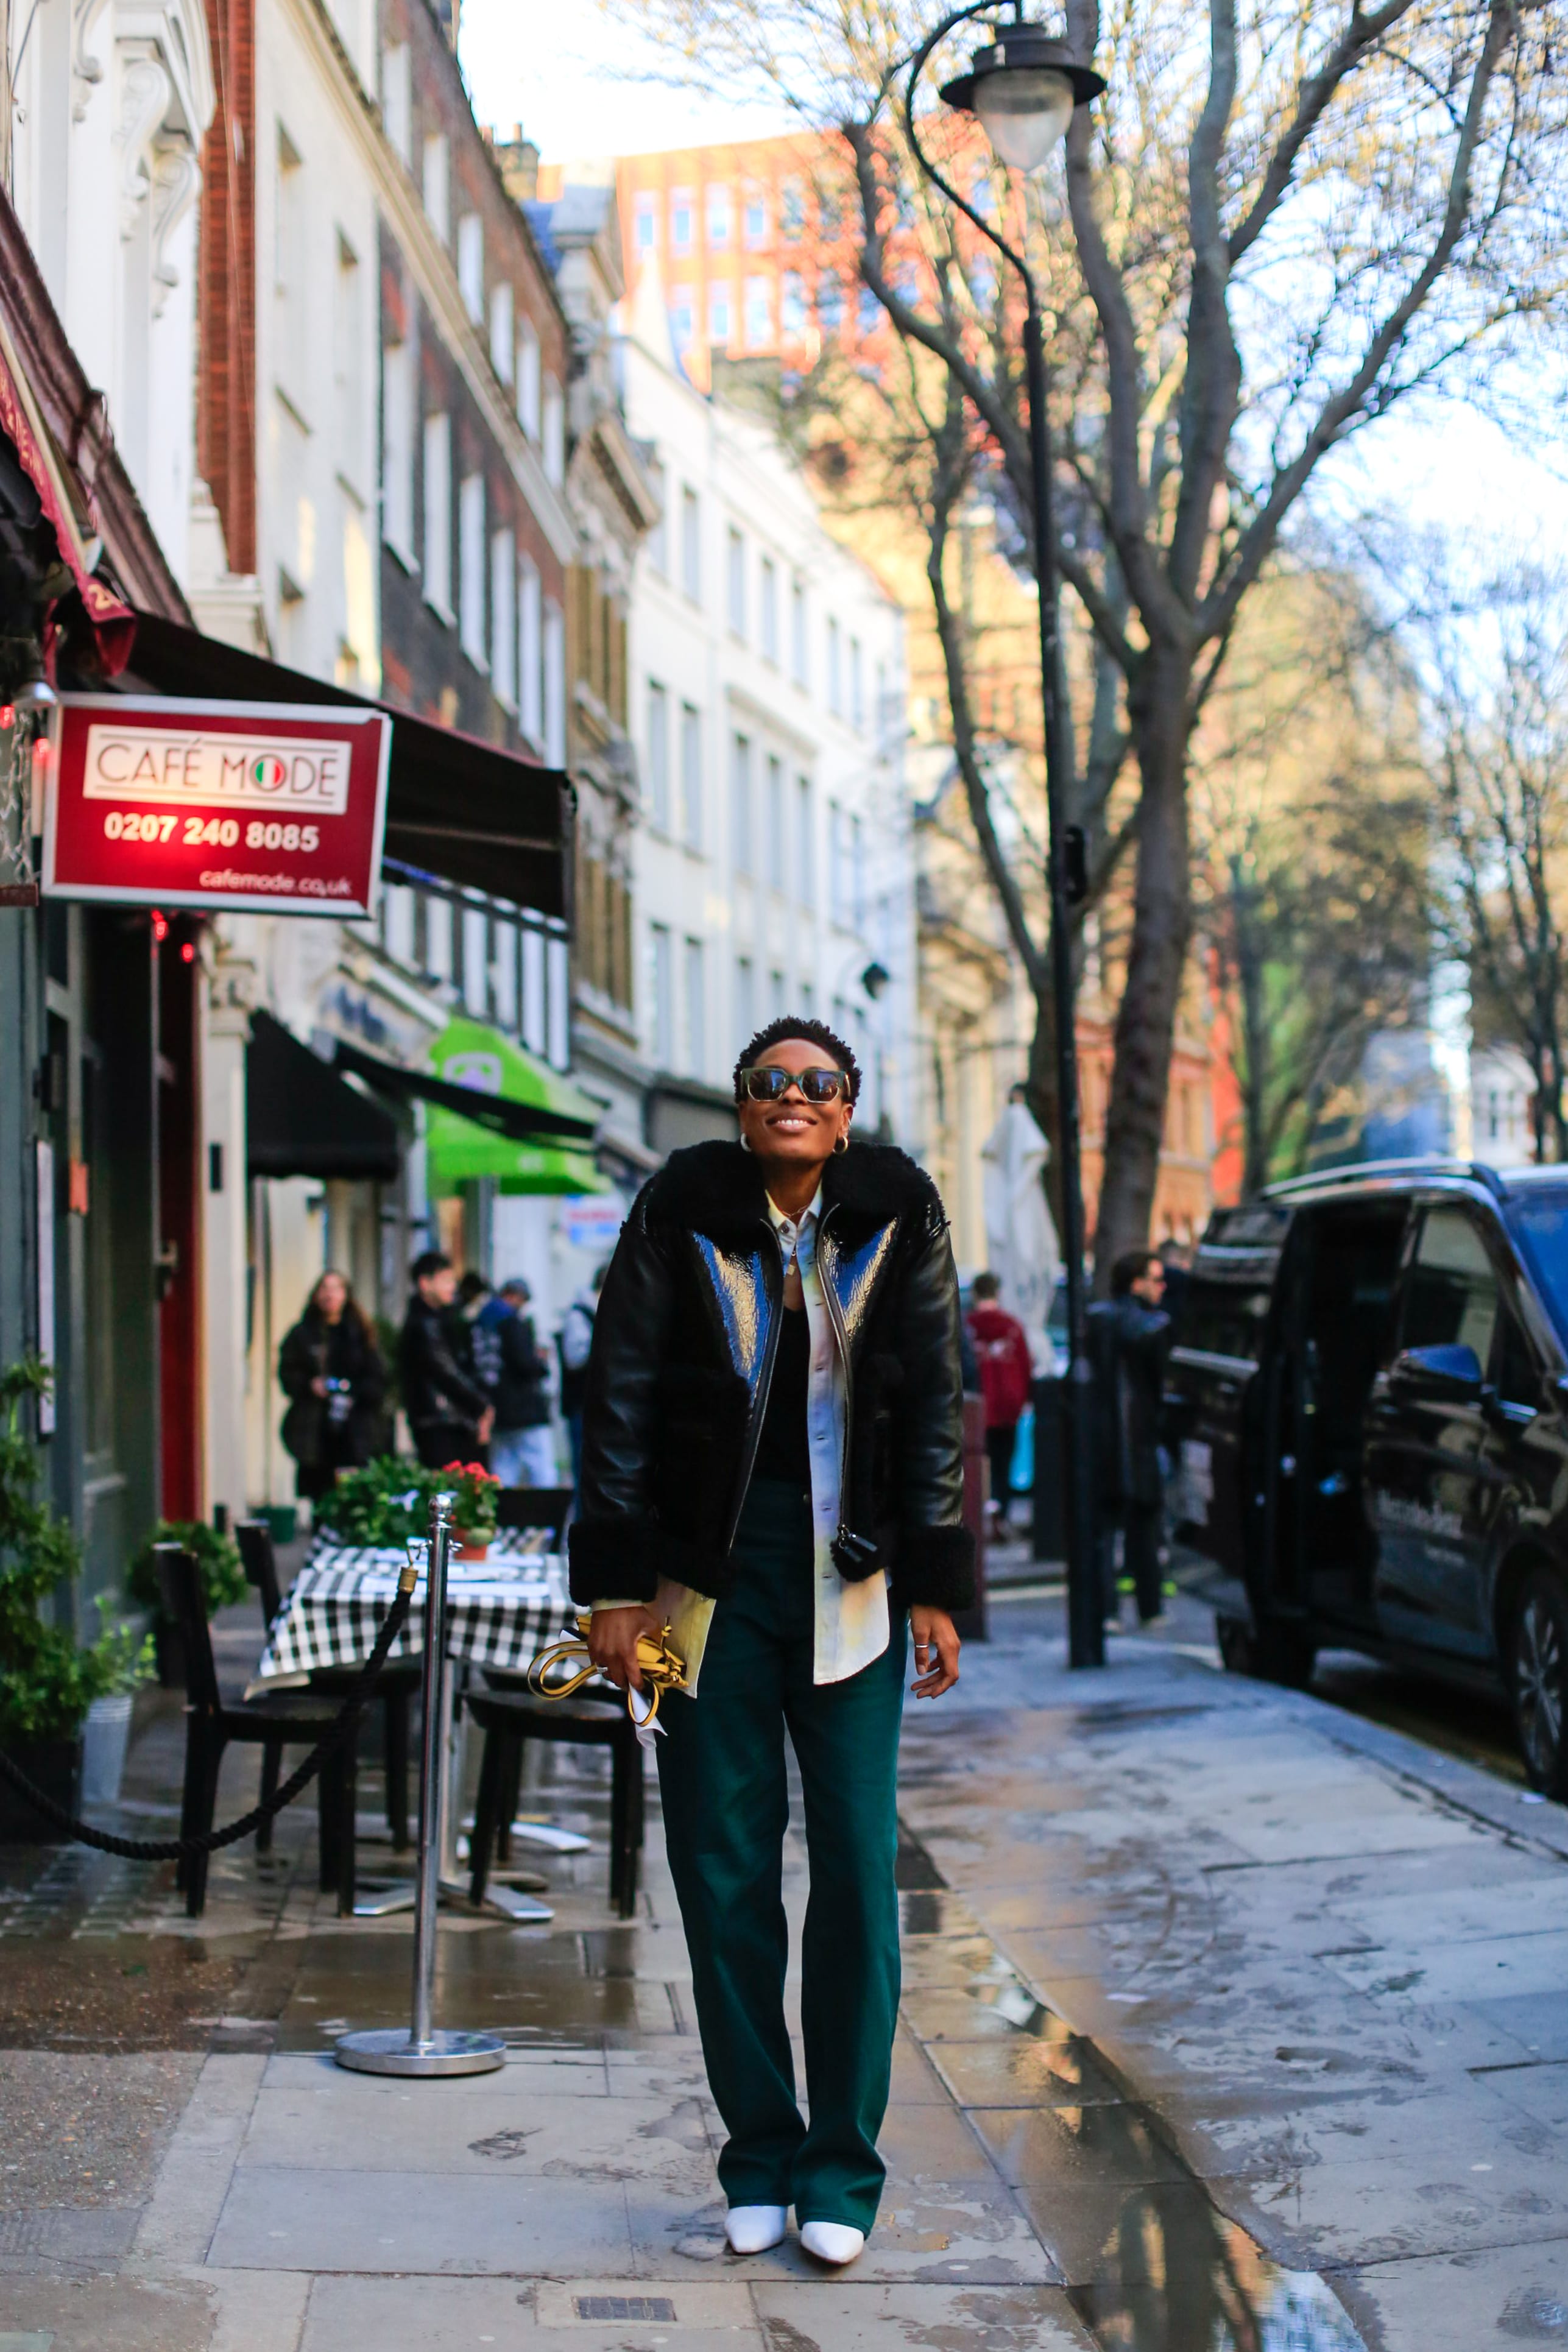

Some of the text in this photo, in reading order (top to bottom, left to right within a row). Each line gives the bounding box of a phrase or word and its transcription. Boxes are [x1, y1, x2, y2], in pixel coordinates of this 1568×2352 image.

[97, 738, 338, 797] CAFÉ MODE
[104, 811, 320, 853] 0207 240 8085
